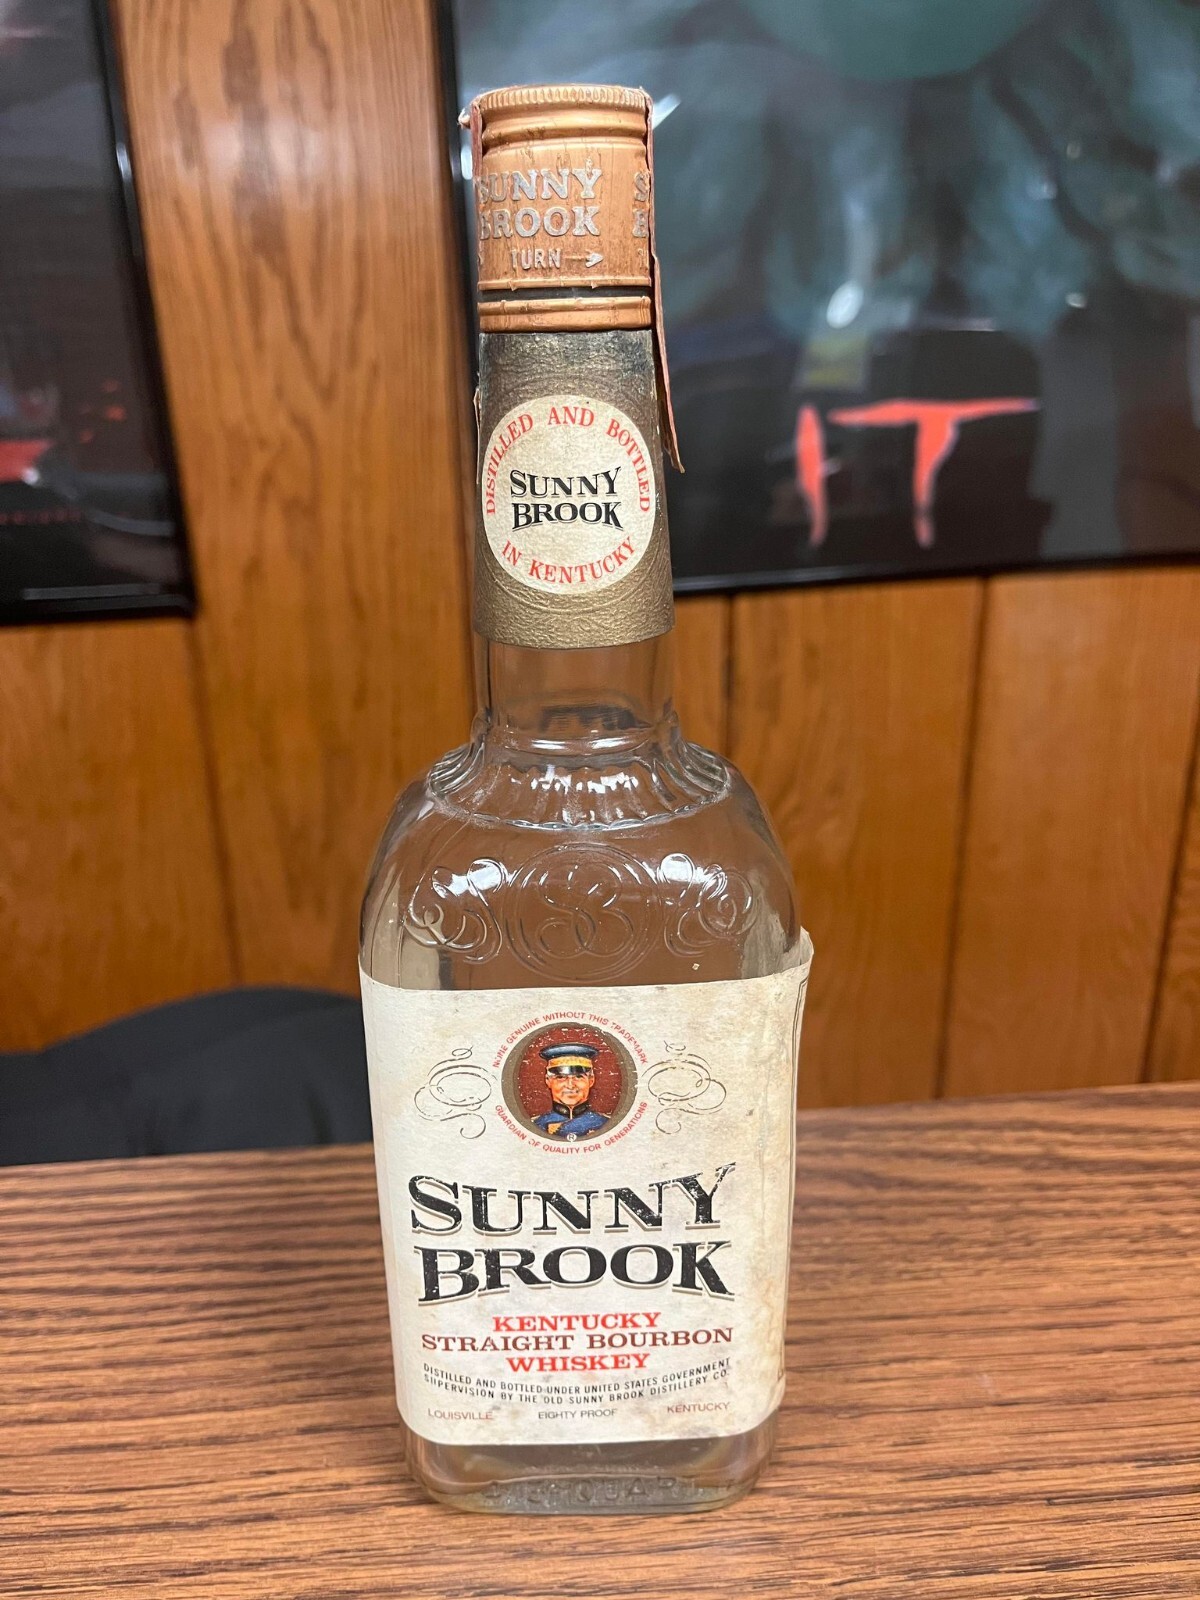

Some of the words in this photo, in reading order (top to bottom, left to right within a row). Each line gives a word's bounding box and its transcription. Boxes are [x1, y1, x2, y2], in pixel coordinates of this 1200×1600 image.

[511, 248, 562, 270] TURN
[486, 413, 534, 515] DISTILLED
[547, 406, 595, 427] AND
[606, 418, 651, 512] BOTTLED
[794, 397, 1041, 549] IT
[509, 466, 622, 498] SUNNY
[512, 501, 624, 532] BROOK
[502, 540, 522, 567] IN
[528, 536, 635, 584] KENTUCKY
[506, 1017, 541, 1044] GENUINE
[543, 1011, 586, 1021] WITHOUT
[589, 1013, 609, 1025] THIS
[495, 1104, 527, 1140] GUARDIAN
[543, 1144, 580, 1155] QUALITY
[583, 1143, 601, 1154] FOR
[604, 1101, 648, 1146] GENERATIONS
[408, 1161, 737, 1236] SUNNY
[413, 1240, 736, 1306] BROOK
[492, 1311, 662, 1332] KENTUCKY
[421, 1333, 574, 1352] STRAIGHT
[586, 1327, 734, 1350] BOURBON
[423, 1362, 472, 1385] DISTILLED
[475, 1378, 497, 1389] AND
[500, 1381, 543, 1394] BOTTLED
[546, 1385, 580, 1395] UNDER
[584, 1383, 620, 1394] UNITED
[624, 1377, 658, 1390] STATES
[662, 1357, 731, 1383] GOVERNMENT
[505, 1353, 651, 1373] WHISKEY
[424, 1373, 495, 1399] SUPERVISION
[501, 1391, 513, 1401] BY
[519, 1393, 537, 1404] THE
[543, 1396, 563, 1405] OLD
[569, 1394, 604, 1405] SUNNY
[609, 1389, 644, 1402] BROOK
[650, 1376, 708, 1396] DISTILLERY
[427, 1408, 494, 1420] LOUISVILLE
[538, 1410, 577, 1420] EIGHTY
[580, 1408, 618, 1418] PROOF
[667, 1401, 730, 1414] KENTUCKY
